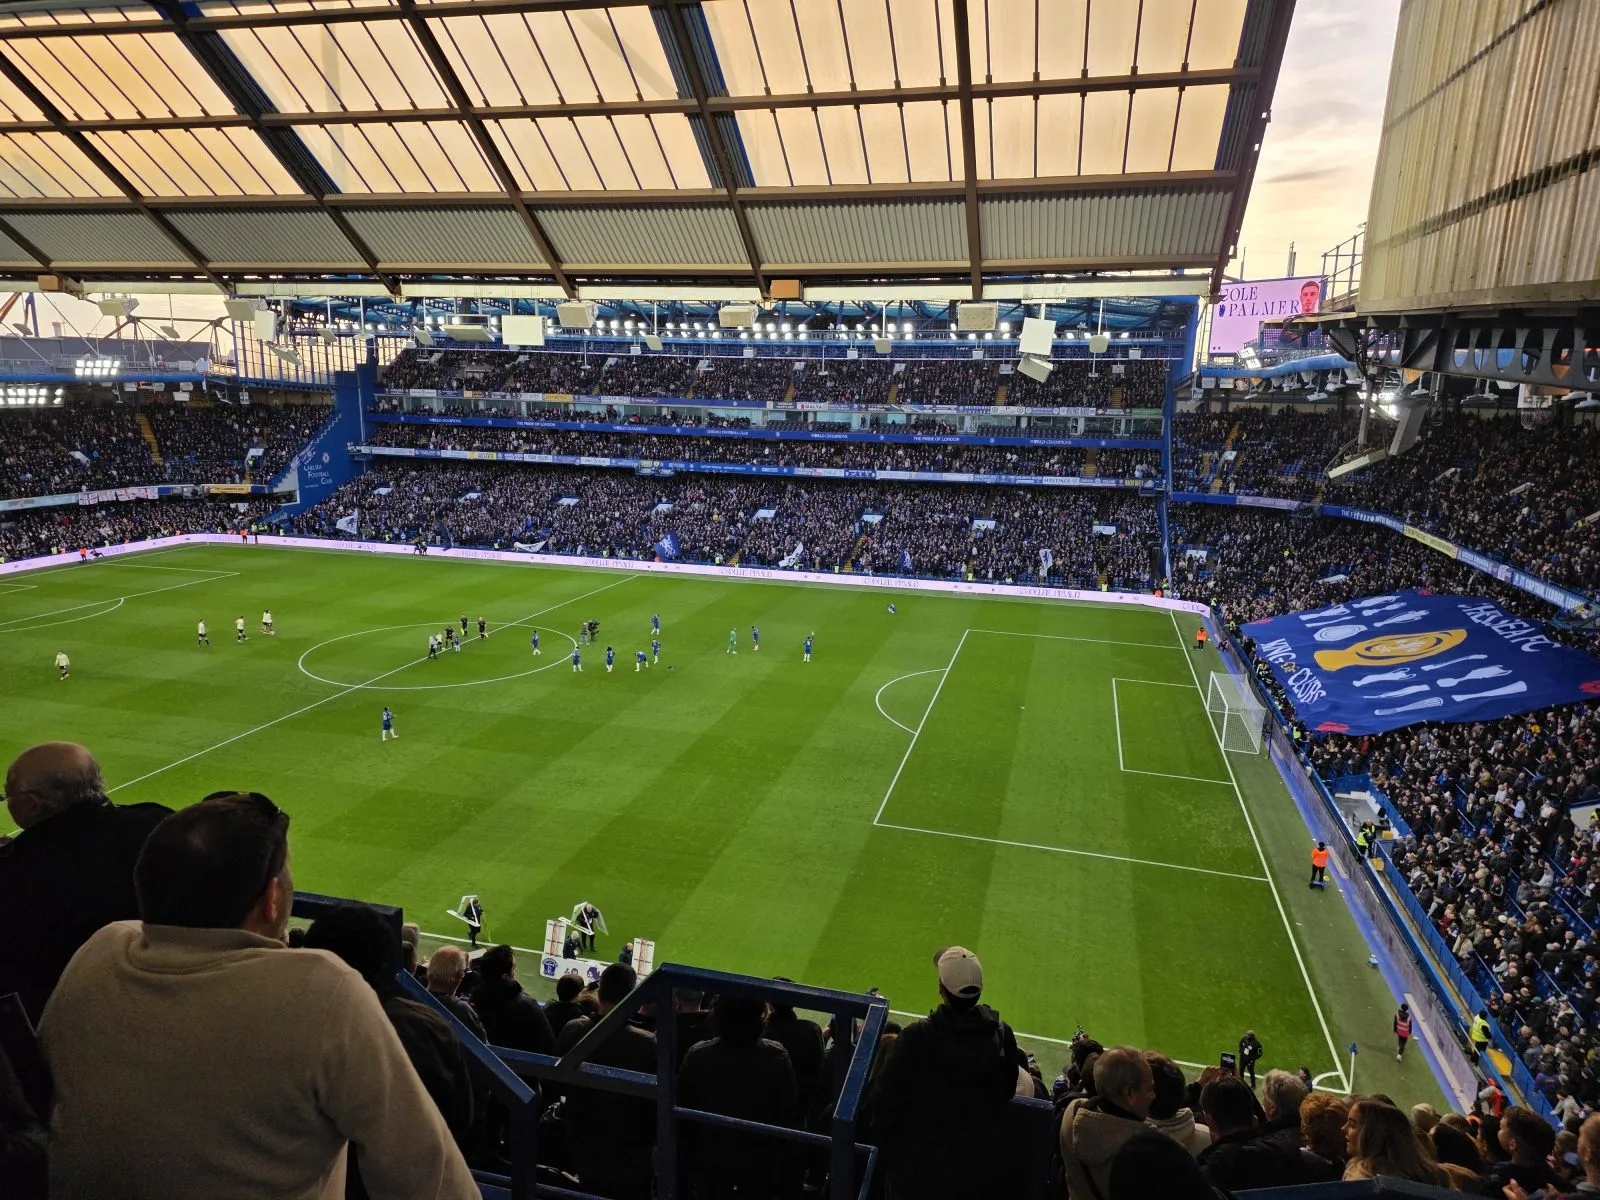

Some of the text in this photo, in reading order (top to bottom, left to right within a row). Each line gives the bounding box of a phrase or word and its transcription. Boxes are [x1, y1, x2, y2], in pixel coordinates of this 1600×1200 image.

[1229, 300, 1300, 318] PALMER
[307, 471, 330, 479] FOOTBALL
[1457, 602, 1562, 653] CHELSEA FC
[1288, 667, 1327, 704] CLUBS
